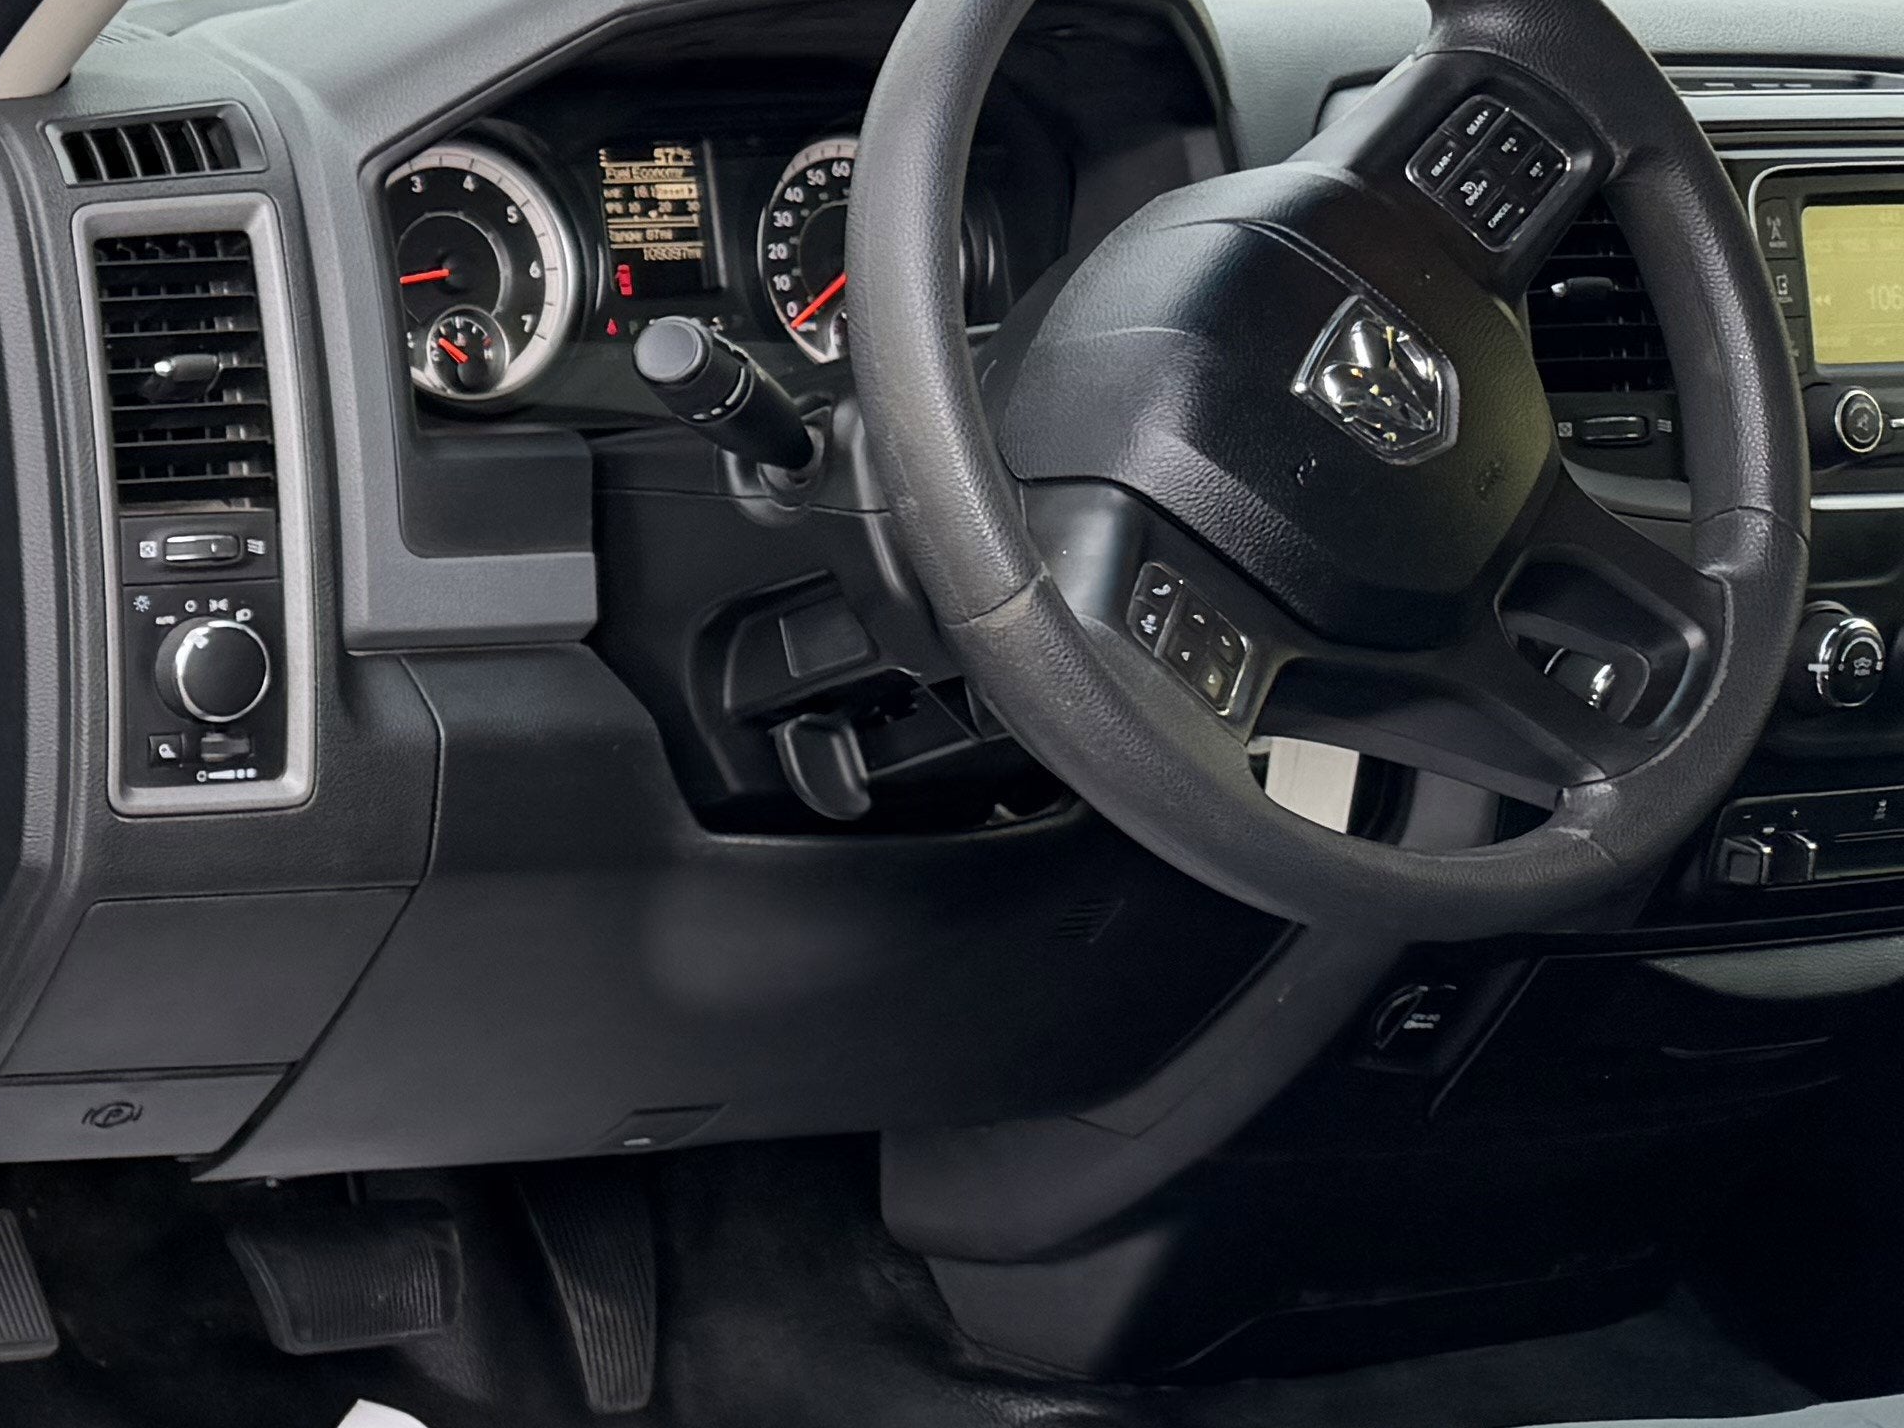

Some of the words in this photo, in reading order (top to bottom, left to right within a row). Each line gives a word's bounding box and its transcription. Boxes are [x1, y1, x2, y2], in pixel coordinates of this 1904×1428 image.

[806, 169, 826, 186] 50
[832, 161, 850, 177] 60
[411, 176, 423, 193] 3
[463, 175, 476, 192] 4
[784, 187, 804, 203] 40
[507, 205, 519, 224] 5
[773, 211, 793, 227] 30
[768, 243, 788, 260] 20
[530, 261, 541, 278] 6
[773, 275, 791, 292] 10
[787, 302, 798, 317] 0
[521, 314, 533, 333] 7
